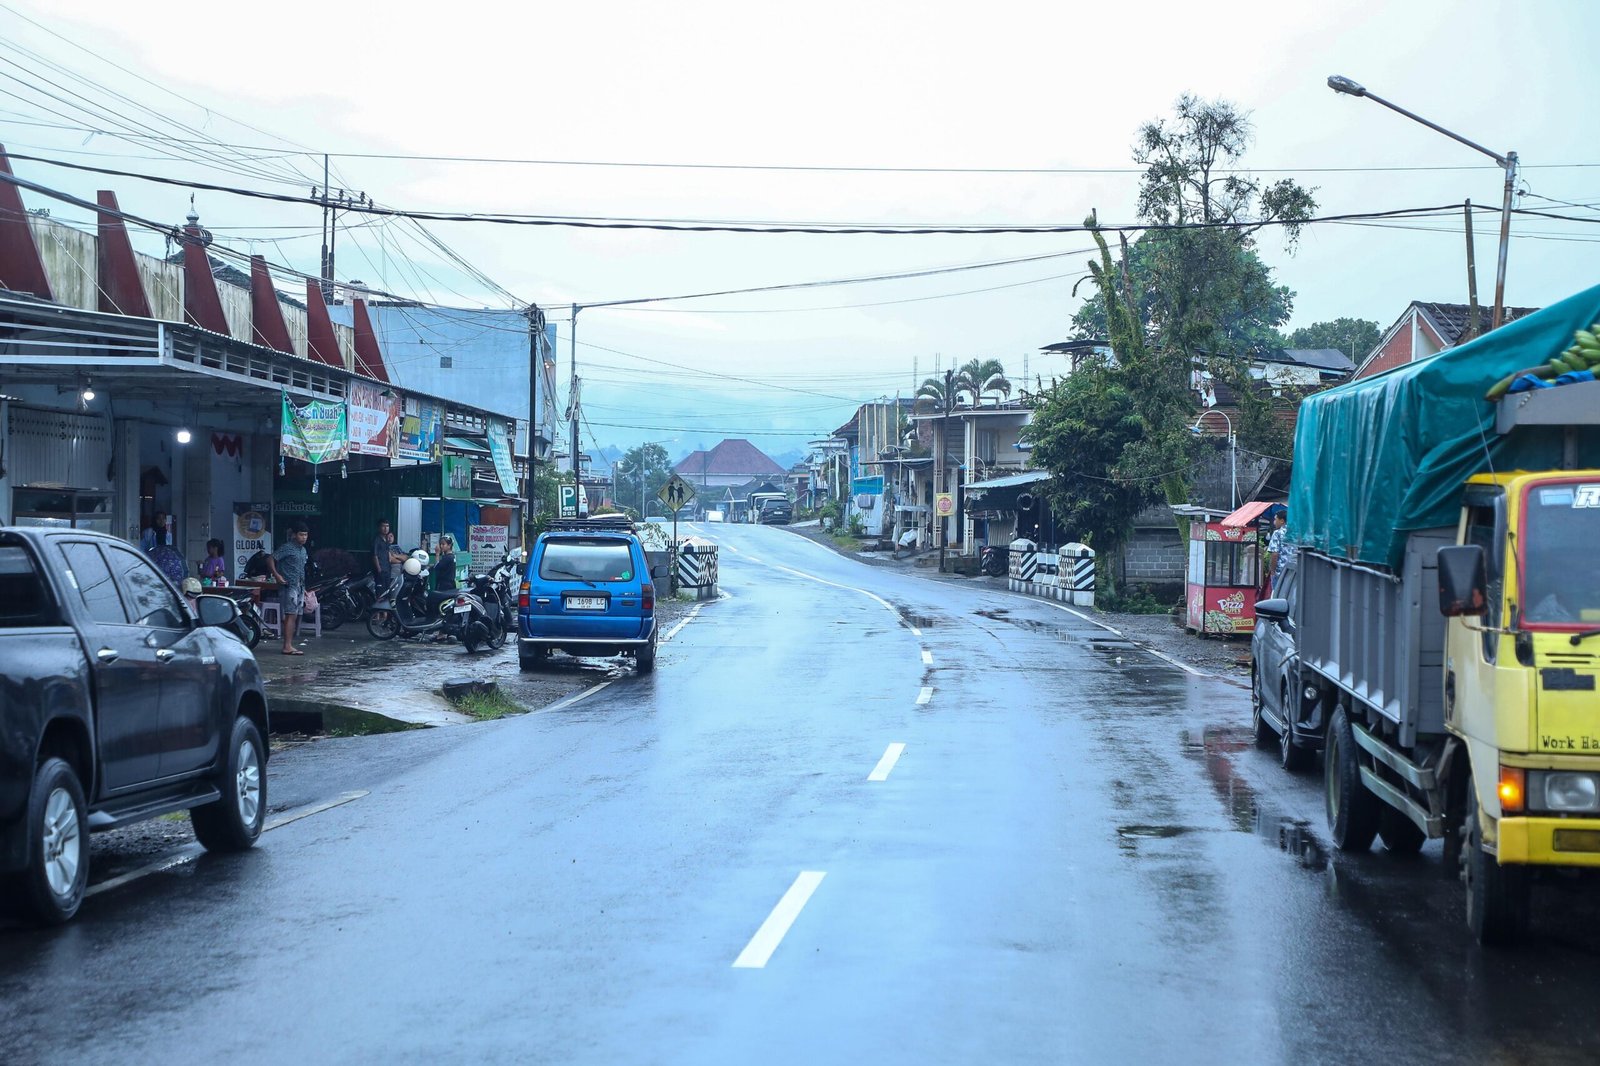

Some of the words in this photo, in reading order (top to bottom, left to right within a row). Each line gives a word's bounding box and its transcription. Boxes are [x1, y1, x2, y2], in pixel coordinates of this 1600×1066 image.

[562, 487, 575, 506] P
[1217, 599, 1244, 610] Pizza
[1541, 735, 1575, 749] Work
